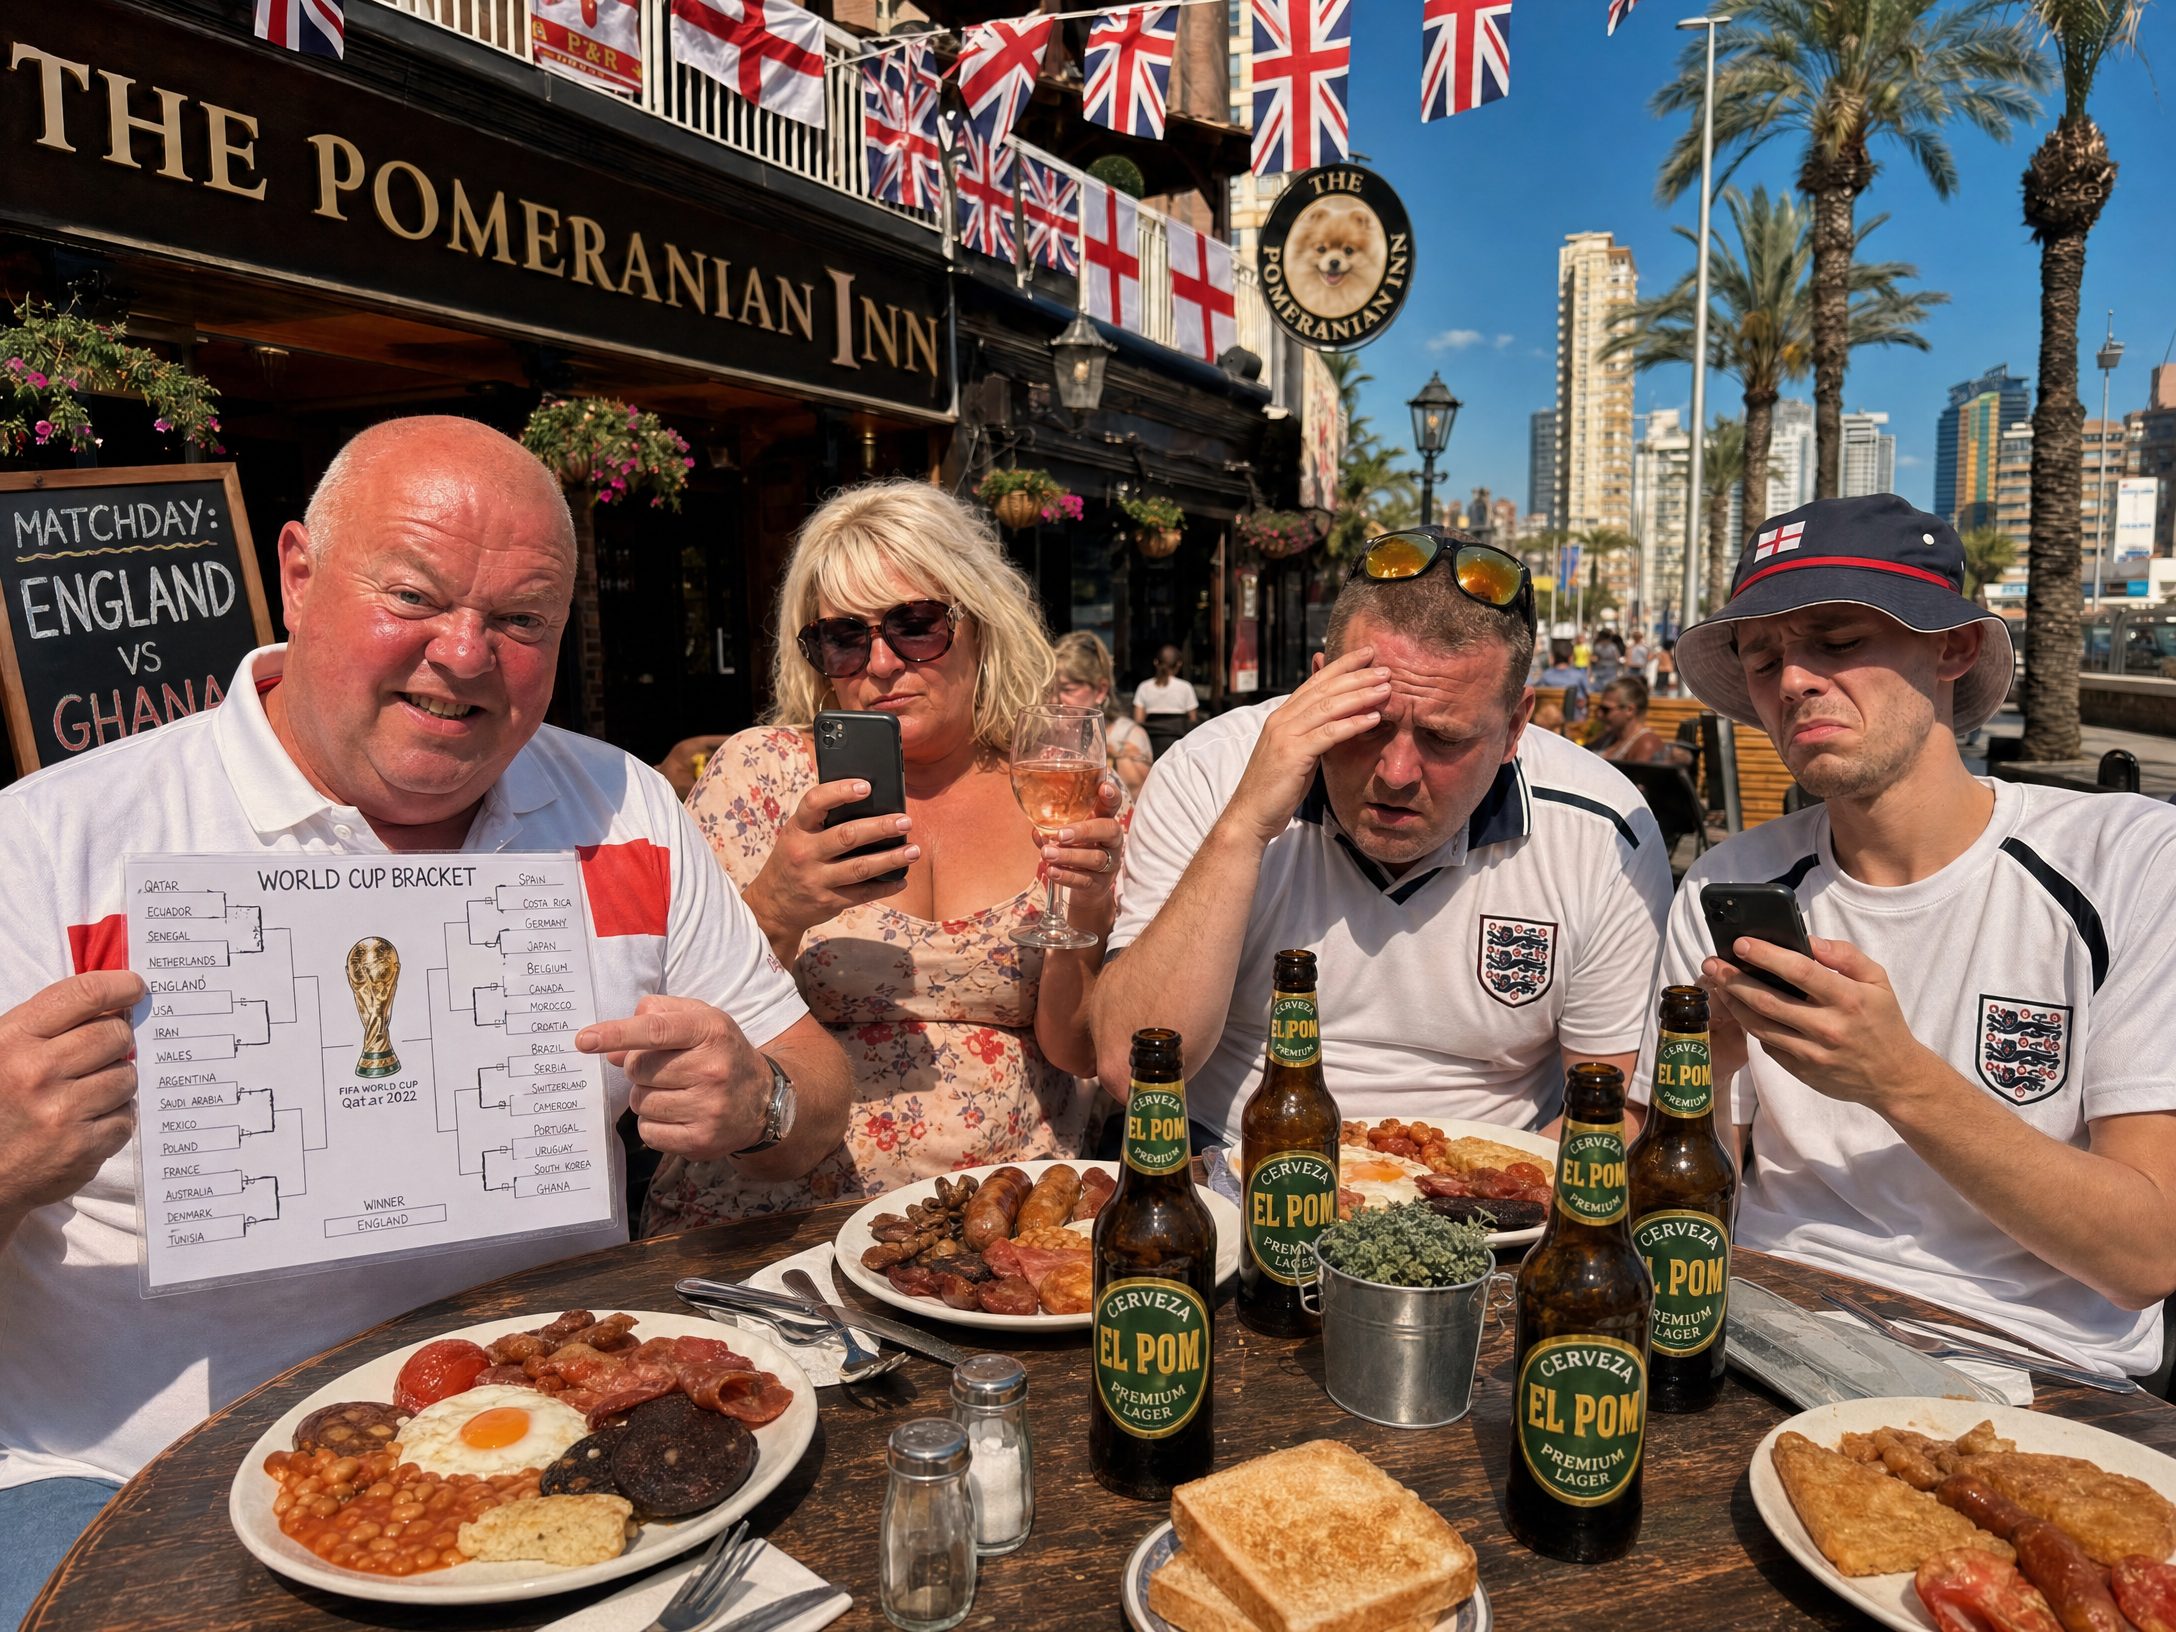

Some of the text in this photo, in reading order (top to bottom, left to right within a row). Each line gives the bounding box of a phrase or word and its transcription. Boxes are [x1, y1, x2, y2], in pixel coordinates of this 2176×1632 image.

[1308, 171, 1364, 195] THE
[6, 41, 938, 378] THE POMERANIAN INN
[1263, 233, 1408, 341] POMERANIAN INN
[14, 499, 218, 548] MATCHDAY:
[20, 561, 236, 639] ENGLAND
[53, 674, 226, 751] GHANA
[144, 880, 179, 892] QATAR
[257, 867, 476, 891] WORLD CUP BRACKET
[518, 873, 546, 886] SPAIN
[148, 906, 192, 917] ECUADOR
[523, 898, 572, 909] COSTA RICA
[525, 918, 567, 929] GERMANY
[148, 931, 190, 942] SENEGAL
[527, 941, 556, 952] JAPAN
[149, 956, 216, 967] NETHERLANDS
[151, 978, 206, 992] ENGLAND
[529, 983, 564, 995] CANADA
[153, 1005, 174, 1016] USA
[530, 1001, 572, 1011] MOROCCO
[155, 1028, 179, 1038] IRAN
[531, 1021, 568, 1033] CROATIA
[1271, 1019, 1318, 1039] EL POM
[157, 1050, 192, 1062] WALES
[531, 1043, 565, 1055] BRAZIL
[1663, 1043, 1708, 1060] CERVEZA
[534, 1063, 567, 1075] SERBIA
[1658, 1063, 1711, 1087] EL POM
[158, 1073, 216, 1086] ARGENTINA
[339, 1080, 418, 1095] FIFA WORLD CUP
[531, 1079, 587, 1094] SWITZERLAND
[160, 1095, 223, 1109] SAUDI ARABIA
[386, 1090, 417, 1104] 2022
[1133, 1095, 1180, 1113] CERVEZA
[1664, 1091, 1707, 1107] PREMIUM
[533, 1100, 578, 1112] CAMEROON
[162, 1120, 197, 1131] MEXICO
[533, 1123, 579, 1136] PORTUGAL
[1128, 1116, 1185, 1141] EL POM
[163, 1142, 198, 1153] POLAND
[535, 1143, 573, 1156] URUGUAY
[1569, 1136, 1622, 1156] CERVEZA
[163, 1165, 200, 1176] FRANCE
[534, 1159, 592, 1175] SOUTH KOREA
[1261, 1161, 1328, 1185] CERVEZA
[1562, 1158, 1626, 1188] EL POM
[165, 1187, 213, 1200] AUSTRALIA
[536, 1181, 570, 1194] GHANA
[363, 1195, 405, 1211] WINNER
[1253, 1190, 1335, 1227] EL POM
[1570, 1193, 1621, 1213] PREMIUM
[167, 1209, 213, 1222] DENMARK
[357, 1213, 409, 1231] ENGLAND
[168, 1233, 204, 1245] TUNISIA
[1640, 1222, 1719, 1251] CERVEZA
[1669, 1256, 1724, 1297] POM
[1107, 1292, 1191, 1323] CERVEZA
[1653, 1306, 1712, 1326] REMIUM
[1654, 1324, 1701, 1340] LAGER
[1100, 1324, 1200, 1375] EL POM
[1540, 1350, 1634, 1384] CERVEZA
[1111, 1381, 1187, 1405] PREMIUM
[1122, 1403, 1173, 1420] LAGER
[1528, 1382, 1640, 1438] EL POM
[1540, 1443, 1626, 1472] PREMIUM
[1554, 1468, 1611, 1487] LAGER
